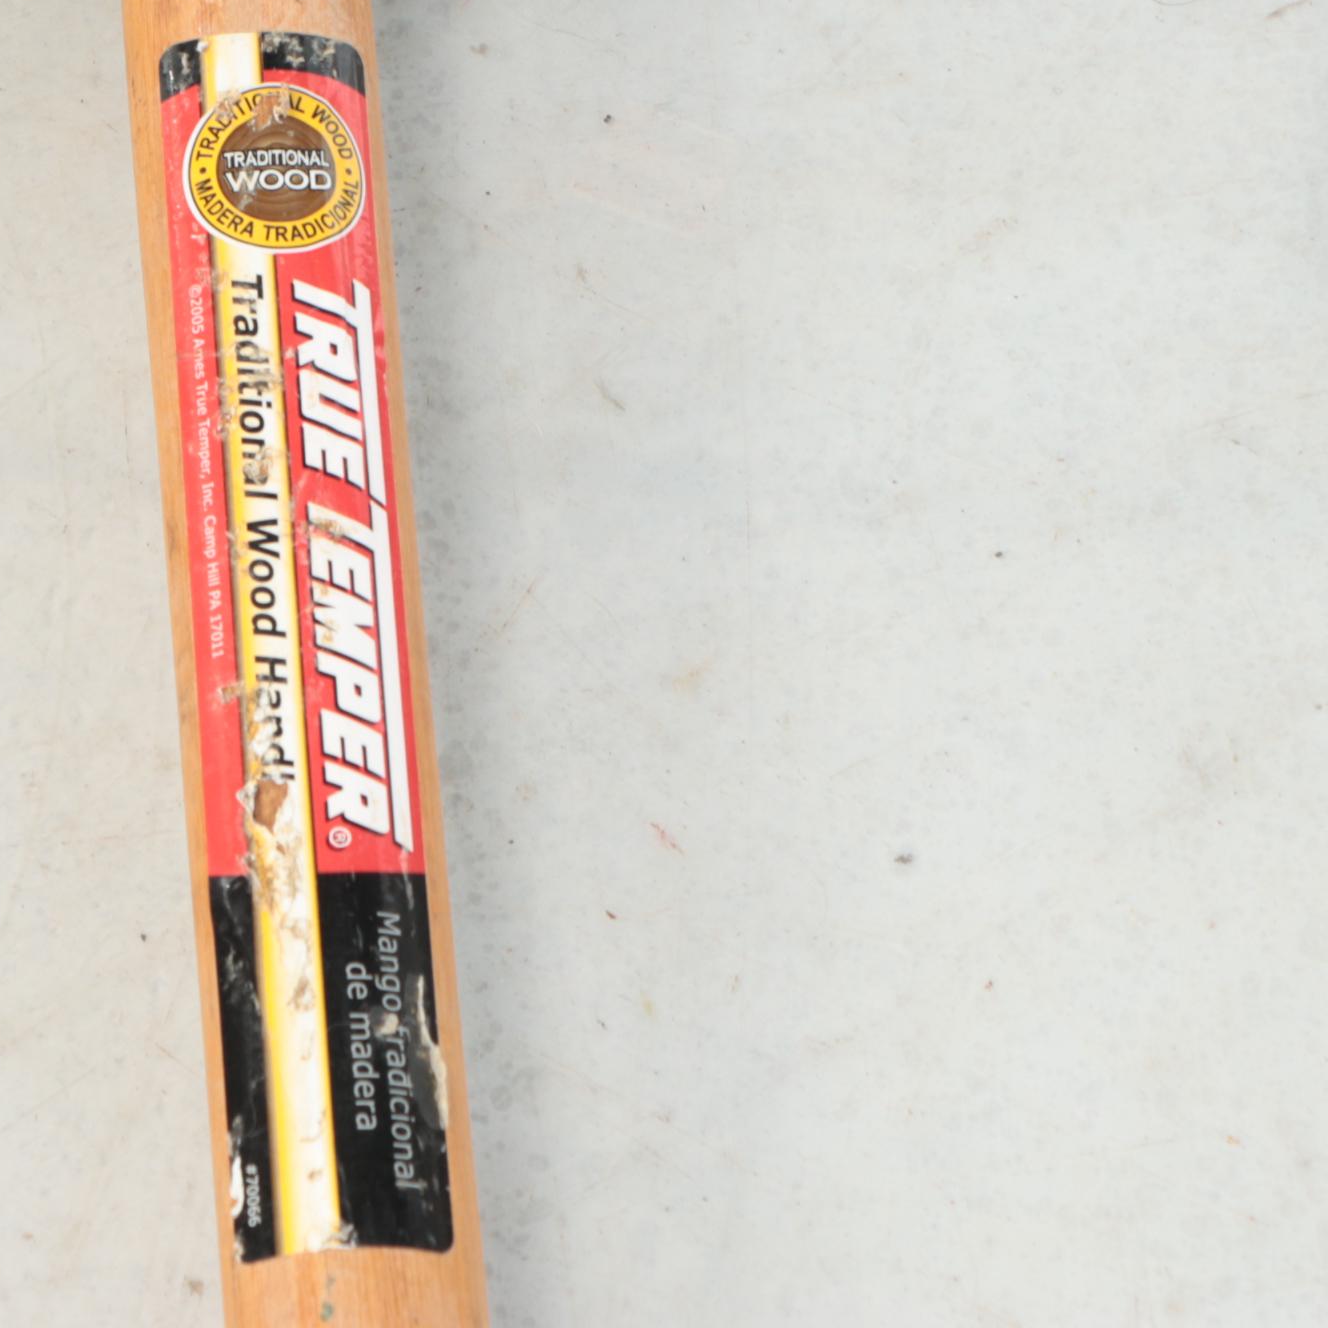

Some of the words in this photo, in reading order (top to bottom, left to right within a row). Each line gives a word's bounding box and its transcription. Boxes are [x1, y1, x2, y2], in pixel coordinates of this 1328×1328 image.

[311, 103, 354, 160] WOOD
[224, 148, 330, 169] TRADITIONAL
[225, 169, 333, 193] WOOD
[195, 178, 254, 238] MADERA
[264, 180, 360, 243] TRADICIONAL
[188, 284, 205, 335] ©2005
[195, 381, 209, 416] True
[231, 274, 278, 500] Traditional
[291, 278, 386, 507] TRUE
[196, 418, 214, 480] Temper,
[202, 482, 215, 511] Inc.
[203, 514, 218, 558] Camp
[205, 561, 220, 587] Hill
[247, 518, 287, 638] Wood
[209, 590, 221, 611] PA
[211, 613, 225, 658] 17011
[344, 961, 369, 999] de
[372, 910, 403, 1012] Mango
[349, 1011, 381, 1132] madera
